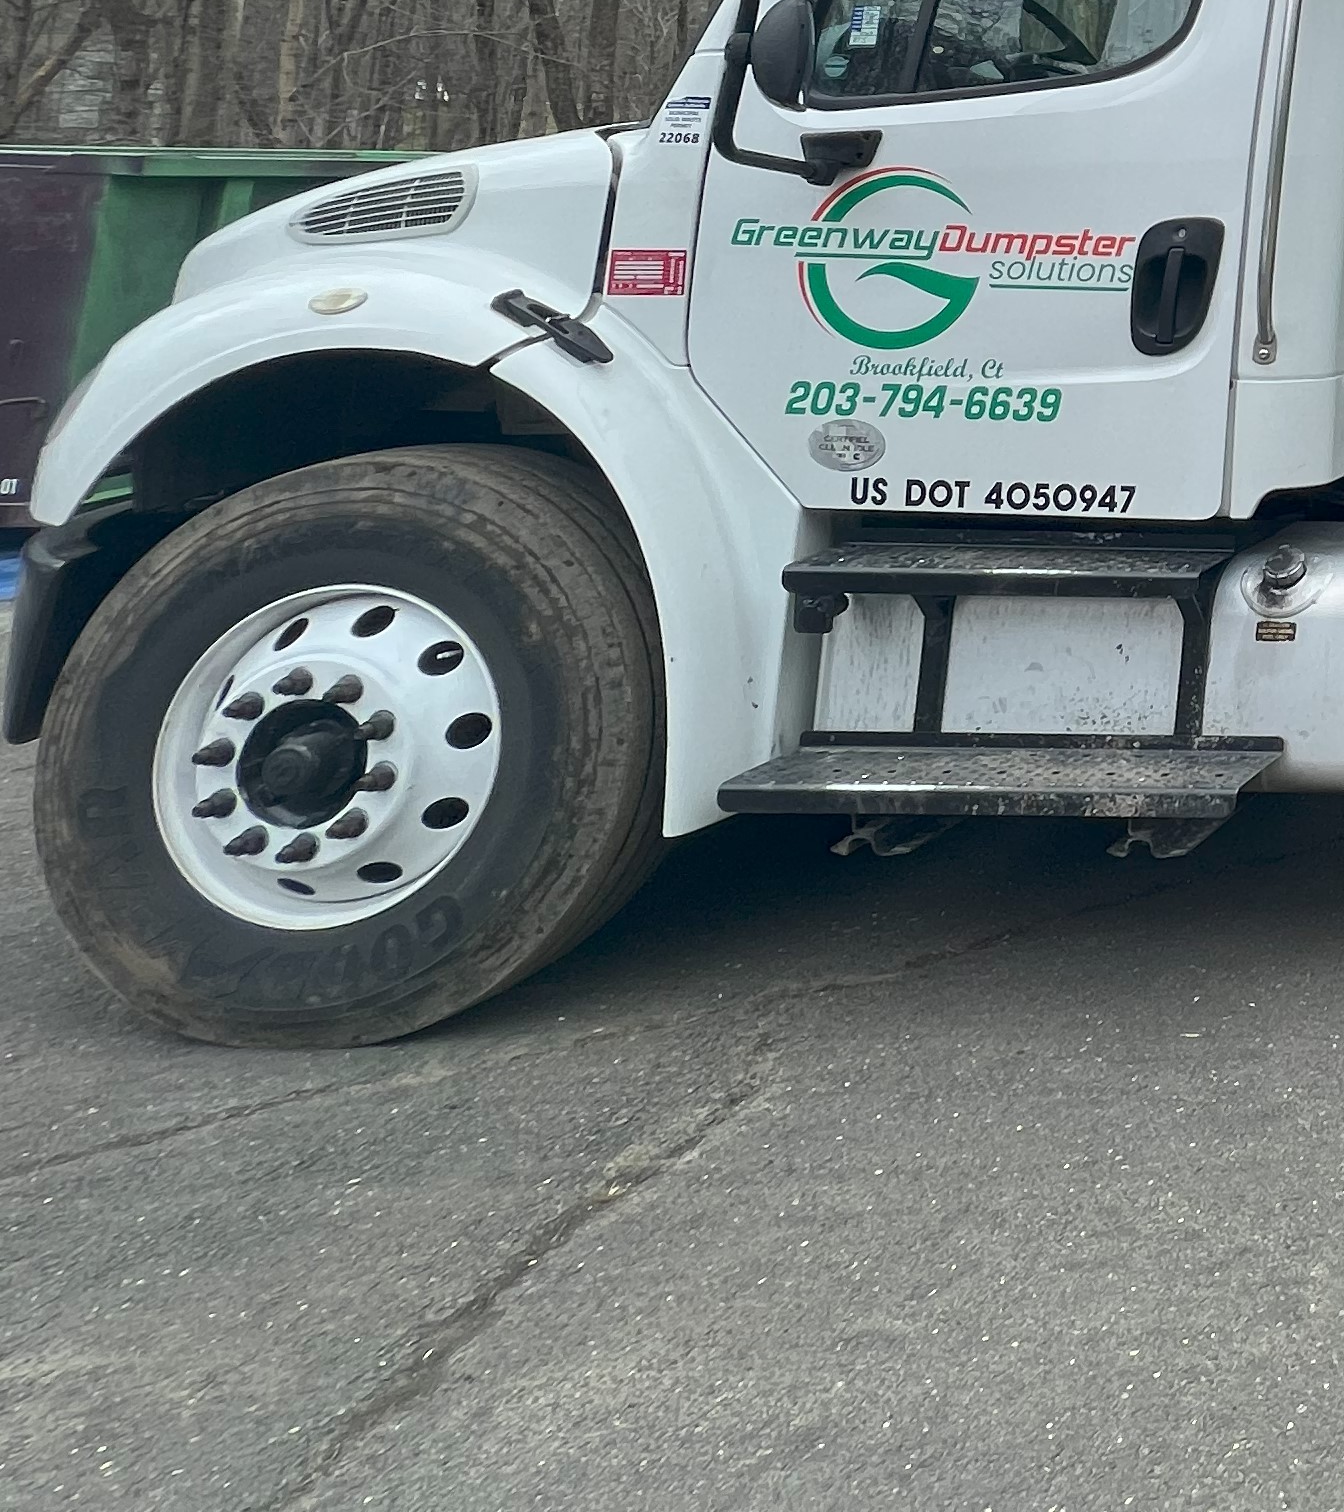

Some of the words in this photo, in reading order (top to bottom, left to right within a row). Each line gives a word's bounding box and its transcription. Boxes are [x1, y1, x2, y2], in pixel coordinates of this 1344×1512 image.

[659, 132, 700, 144] 22068
[988, 254, 1133, 284] solutions
[850, 354, 974, 383] Brookfield,
[981, 358, 1004, 379] Ct
[784, 380, 1063, 422] 203-794-6639
[850, 476, 888, 506] US
[904, 478, 971, 509] DOT
[984, 481, 1137, 514] 4050947
